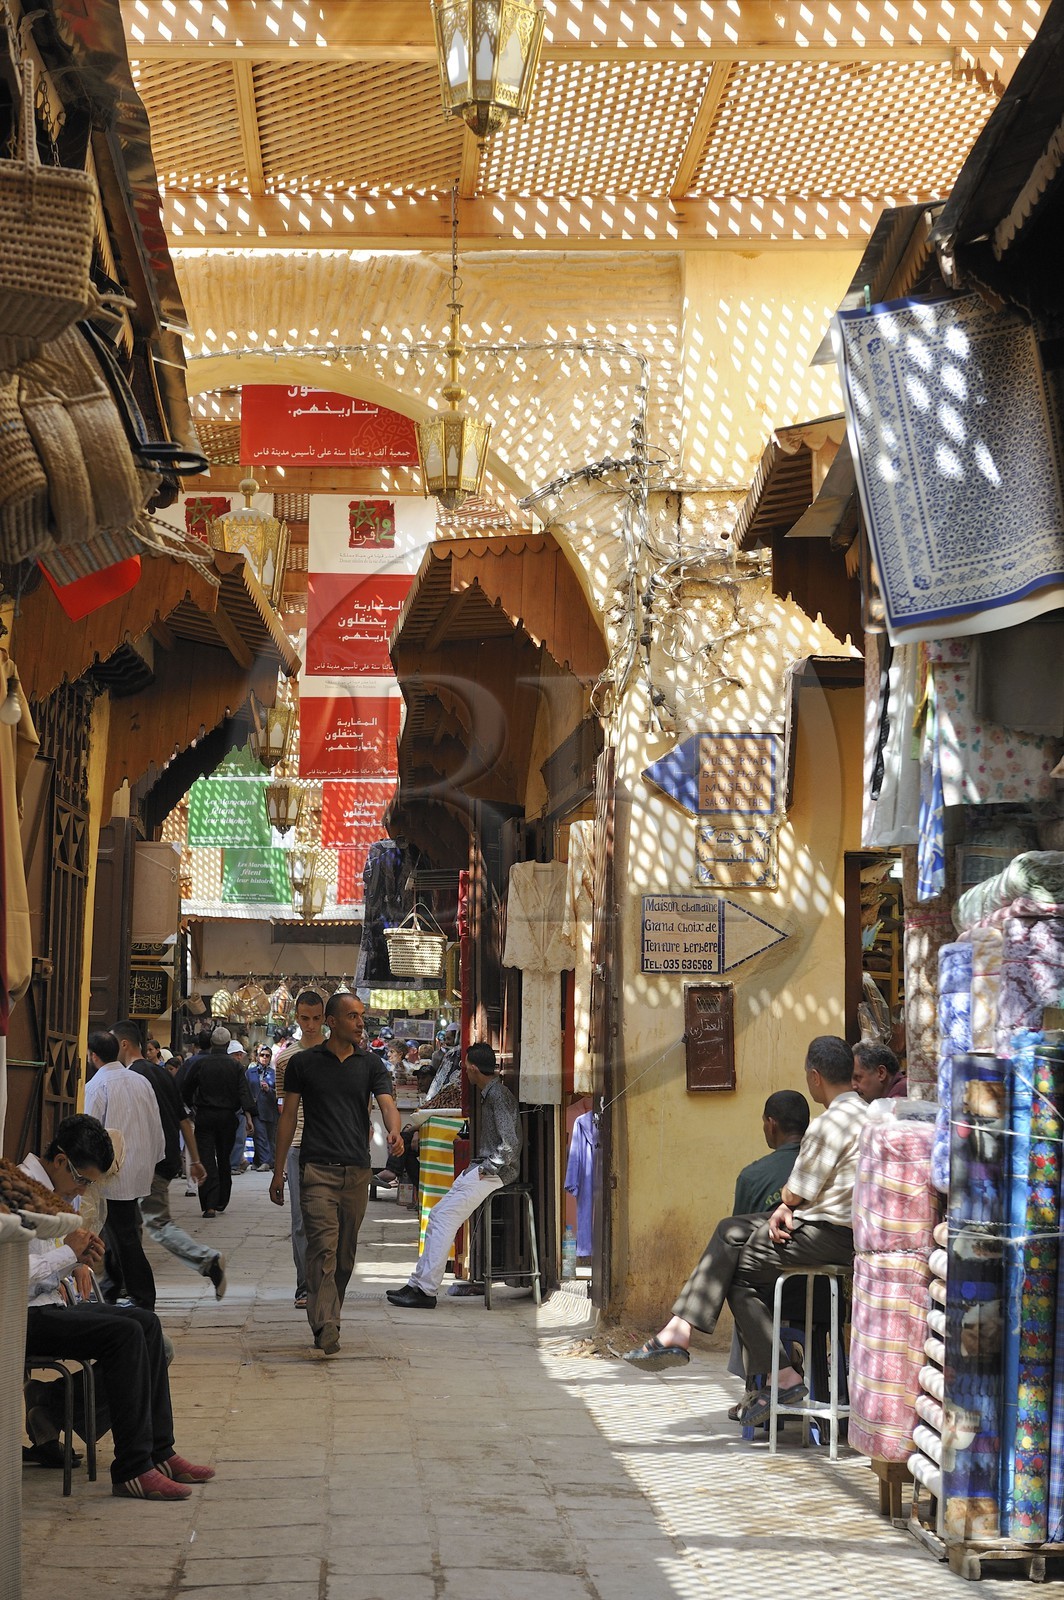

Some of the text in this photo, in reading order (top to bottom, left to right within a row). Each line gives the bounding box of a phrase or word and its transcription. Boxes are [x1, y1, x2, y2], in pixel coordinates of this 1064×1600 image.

[288, 401, 378, 417] بتاريخهم.
[253, 448, 269, 458] فاس
[271, 449, 289, 457] مدينة
[291, 445, 315, 458] تأسيس
[317, 448, 332, 459] على
[373, 445, 387, 457] ألف
[389, 448, 410, 457] جمعية
[354, 600, 404, 611] المغاربة
[338, 613, 386, 627] يحتفلون
[337, 717, 377, 727] المغاربة
[325, 728, 364, 741] يحتفلون
[705, 783, 764, 792] MUSEUM
[705, 798, 731, 807] SALON
[735, 798, 746, 807] DE
[645, 899, 680, 912] Maison
[645, 919, 674, 932] Grand
[705, 922, 718, 932] de
[645, 940, 680, 952] Tenture
[681, 959, 713, 970] 636568
